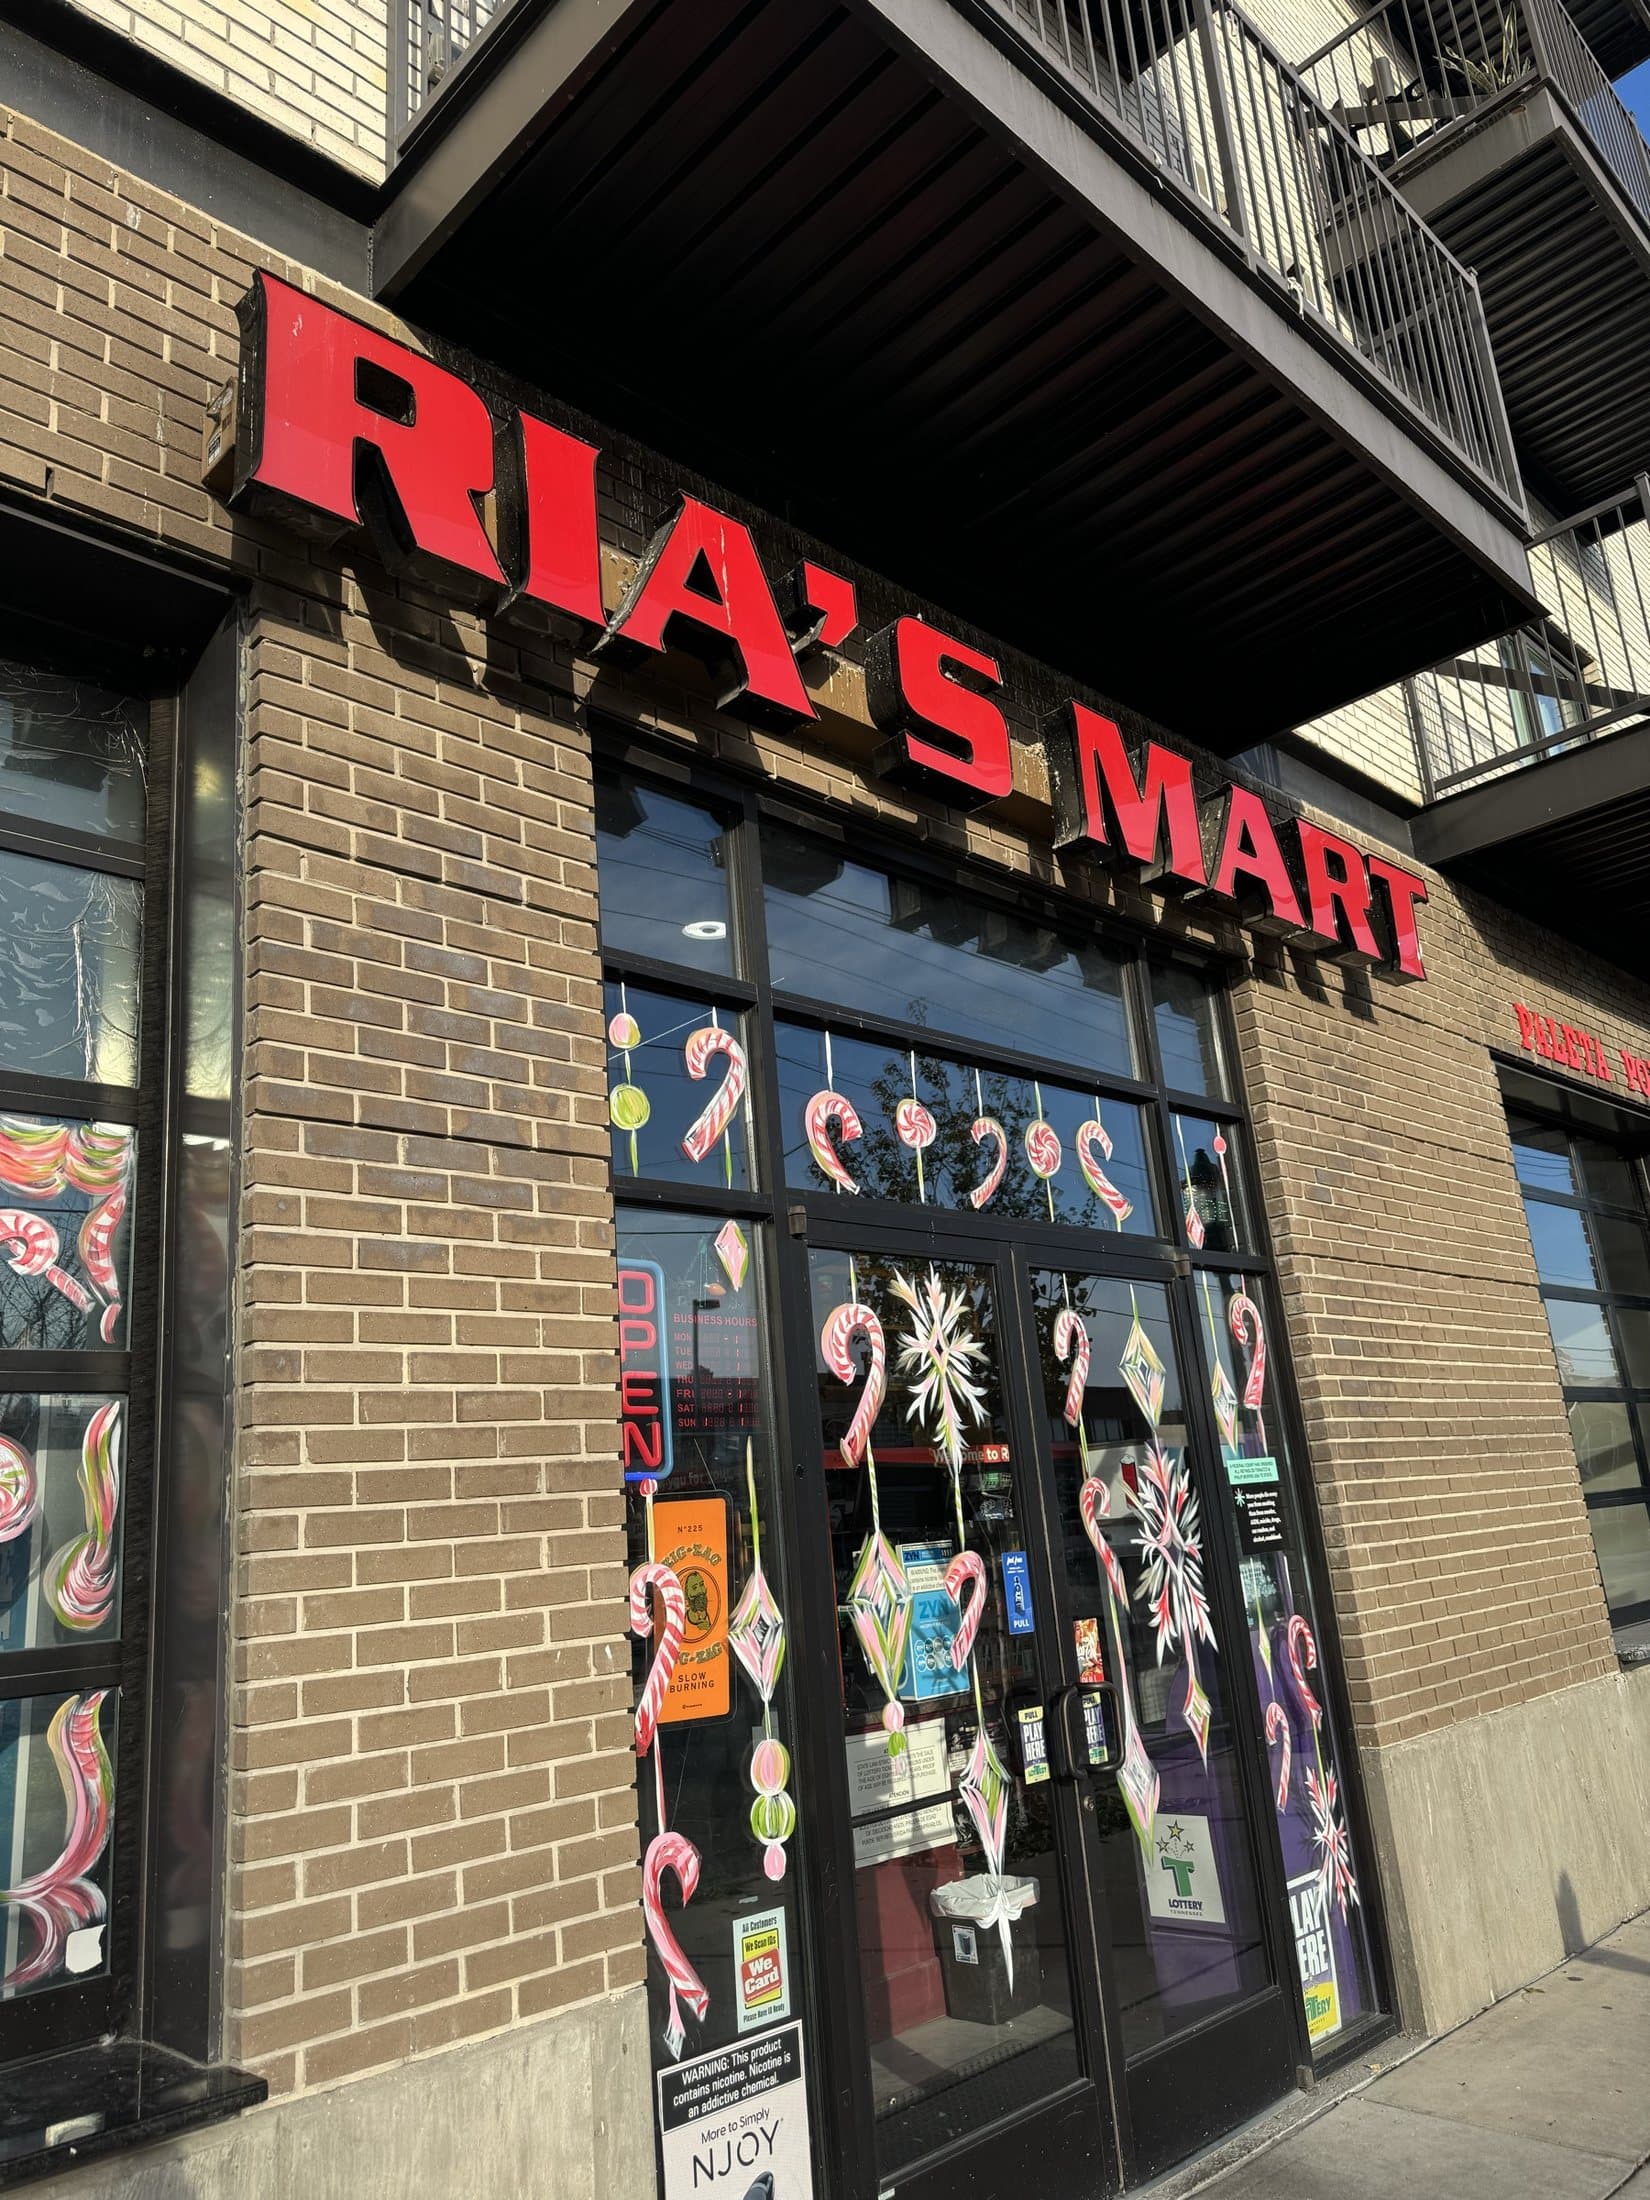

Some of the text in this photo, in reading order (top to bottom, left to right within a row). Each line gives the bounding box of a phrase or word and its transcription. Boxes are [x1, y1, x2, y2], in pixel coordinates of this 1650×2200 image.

[252, 268, 1428, 981] RIA'S MART
[1513, 1002, 1612, 1082] PALETA
[673, 1313, 758, 1328] BUSINESS HOURS
[675, 1346, 693, 1356] TUE
[619, 1270, 663, 1468] OPEN
[676, 1360, 694, 1370] WED
[676, 1374, 694, 1384] THU
[676, 1388, 695, 1398] FRI
[677, 1403, 696, 1413] SAT
[678, 1418, 696, 1427] SUN
[986, 1448, 999, 1460] to
[918, 1598, 949, 1619] ZYN
[1014, 1619, 1030, 1629] PULL
[678, 1671, 707, 1683] SLOW
[669, 1680, 715, 1694] BURNING
[1024, 1709, 1038, 1720] PULL
[1023, 1719, 1043, 1744] PLAY
[1025, 1739, 1046, 1762] HERE
[1168, 1898, 1203, 1911] LOTTERY
[1289, 1886, 1321, 1938] LAY
[750, 1916, 777, 1931] Customers
[745, 1935, 776, 1952] We Scan IDs
[1296, 1929, 1330, 1982] ERE
[748, 1956, 773, 1977] We
[744, 1965, 780, 1995] Card
[681, 2038, 782, 2086] WARNING: This product
[673, 2050, 791, 2106] contains nicotine. Nicotine is
[688, 2071, 780, 2119] an addictive chemical.
[701, 2107, 770, 2144] More to Simply
[693, 2119, 780, 2189] NJOY
